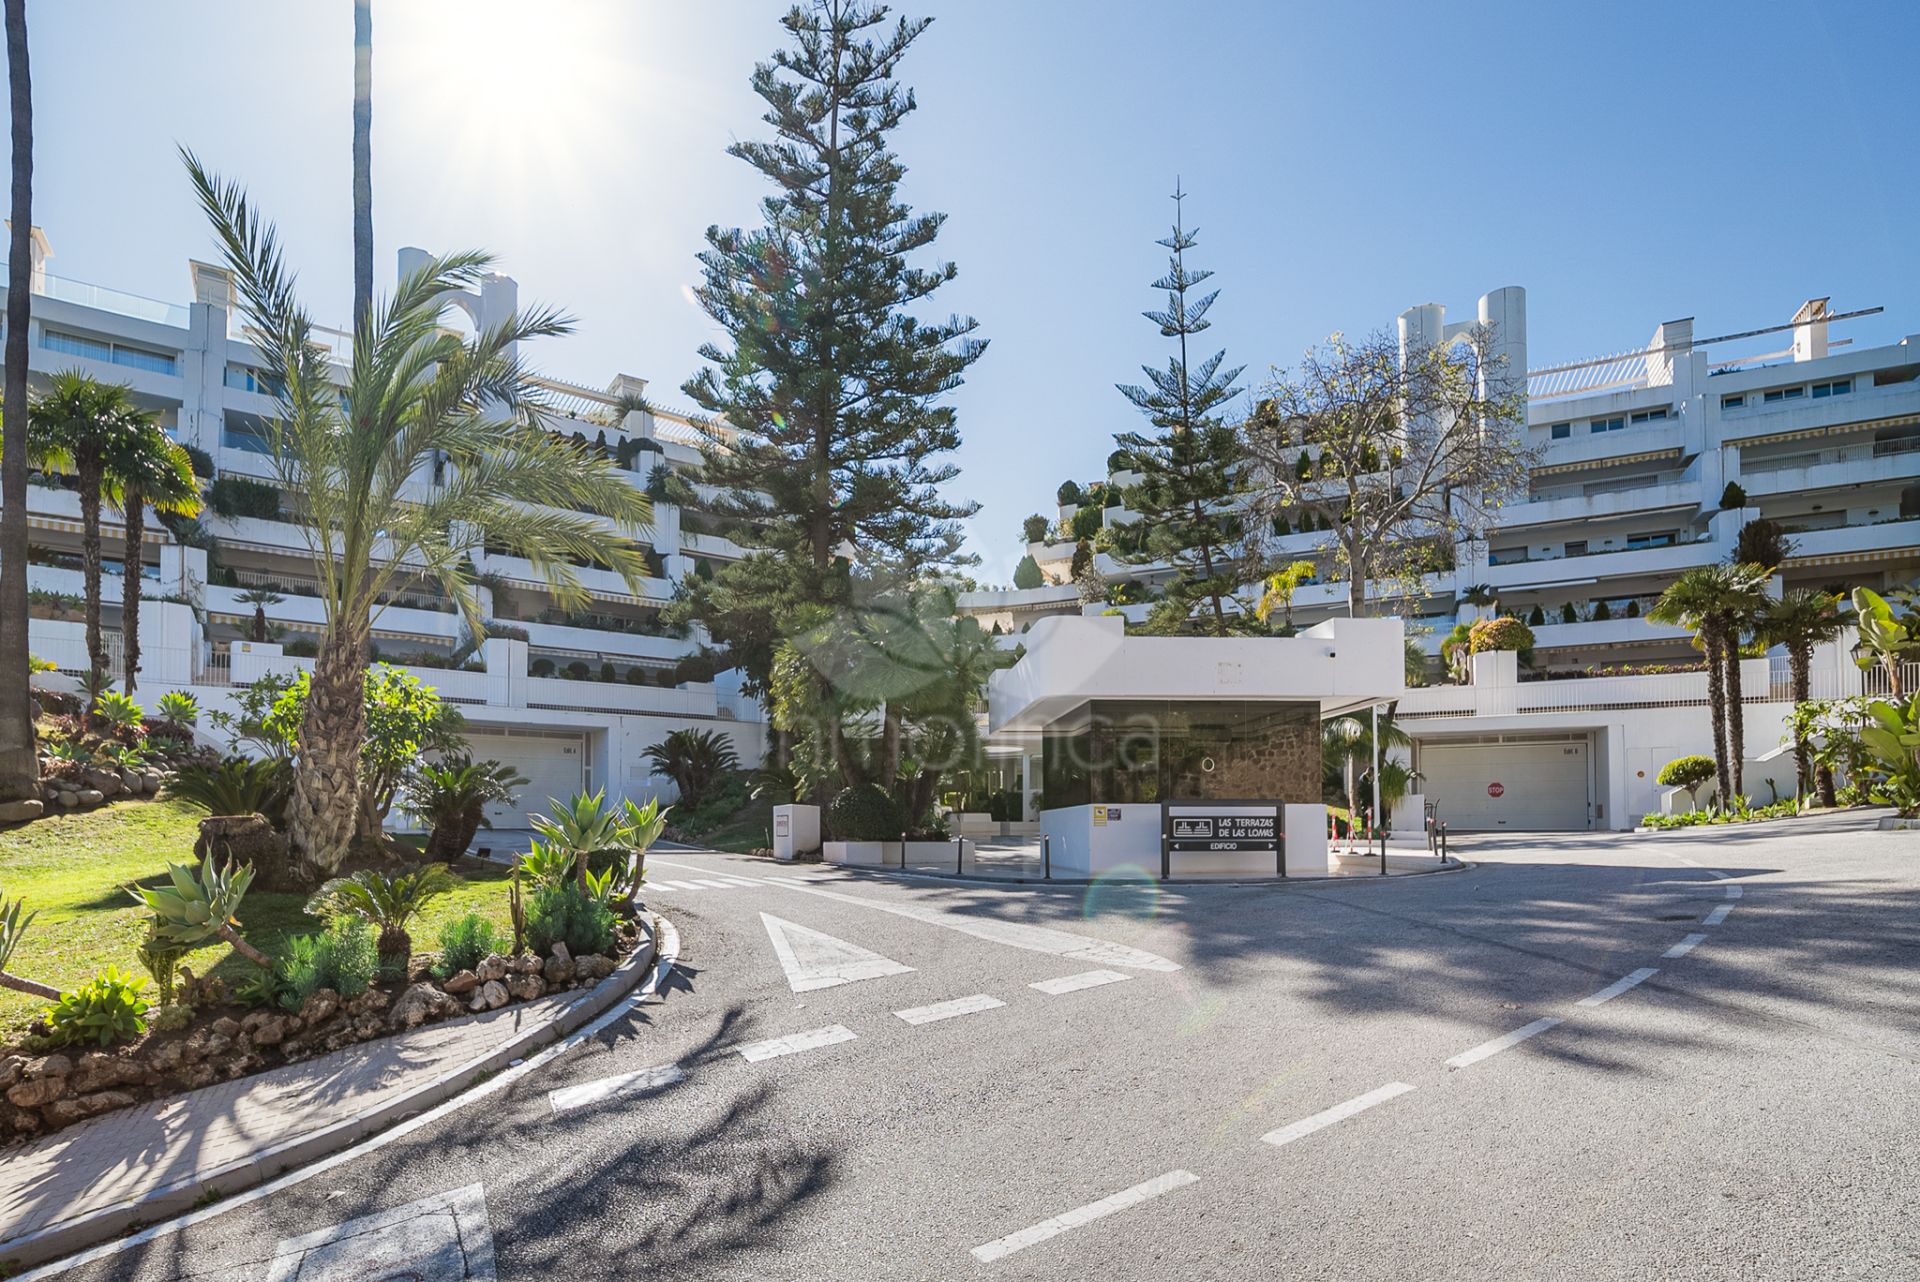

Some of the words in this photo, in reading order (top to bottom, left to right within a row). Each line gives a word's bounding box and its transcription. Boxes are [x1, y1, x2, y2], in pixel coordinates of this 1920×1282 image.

[1488, 786, 1504, 794] STOP
[1219, 819, 1232, 827] LAS
[1235, 819, 1274, 827] TERRAZAS
[1219, 829, 1229, 837] DE
[1232, 829, 1245, 837] LAS
[1248, 829, 1274, 837] LOMAS
